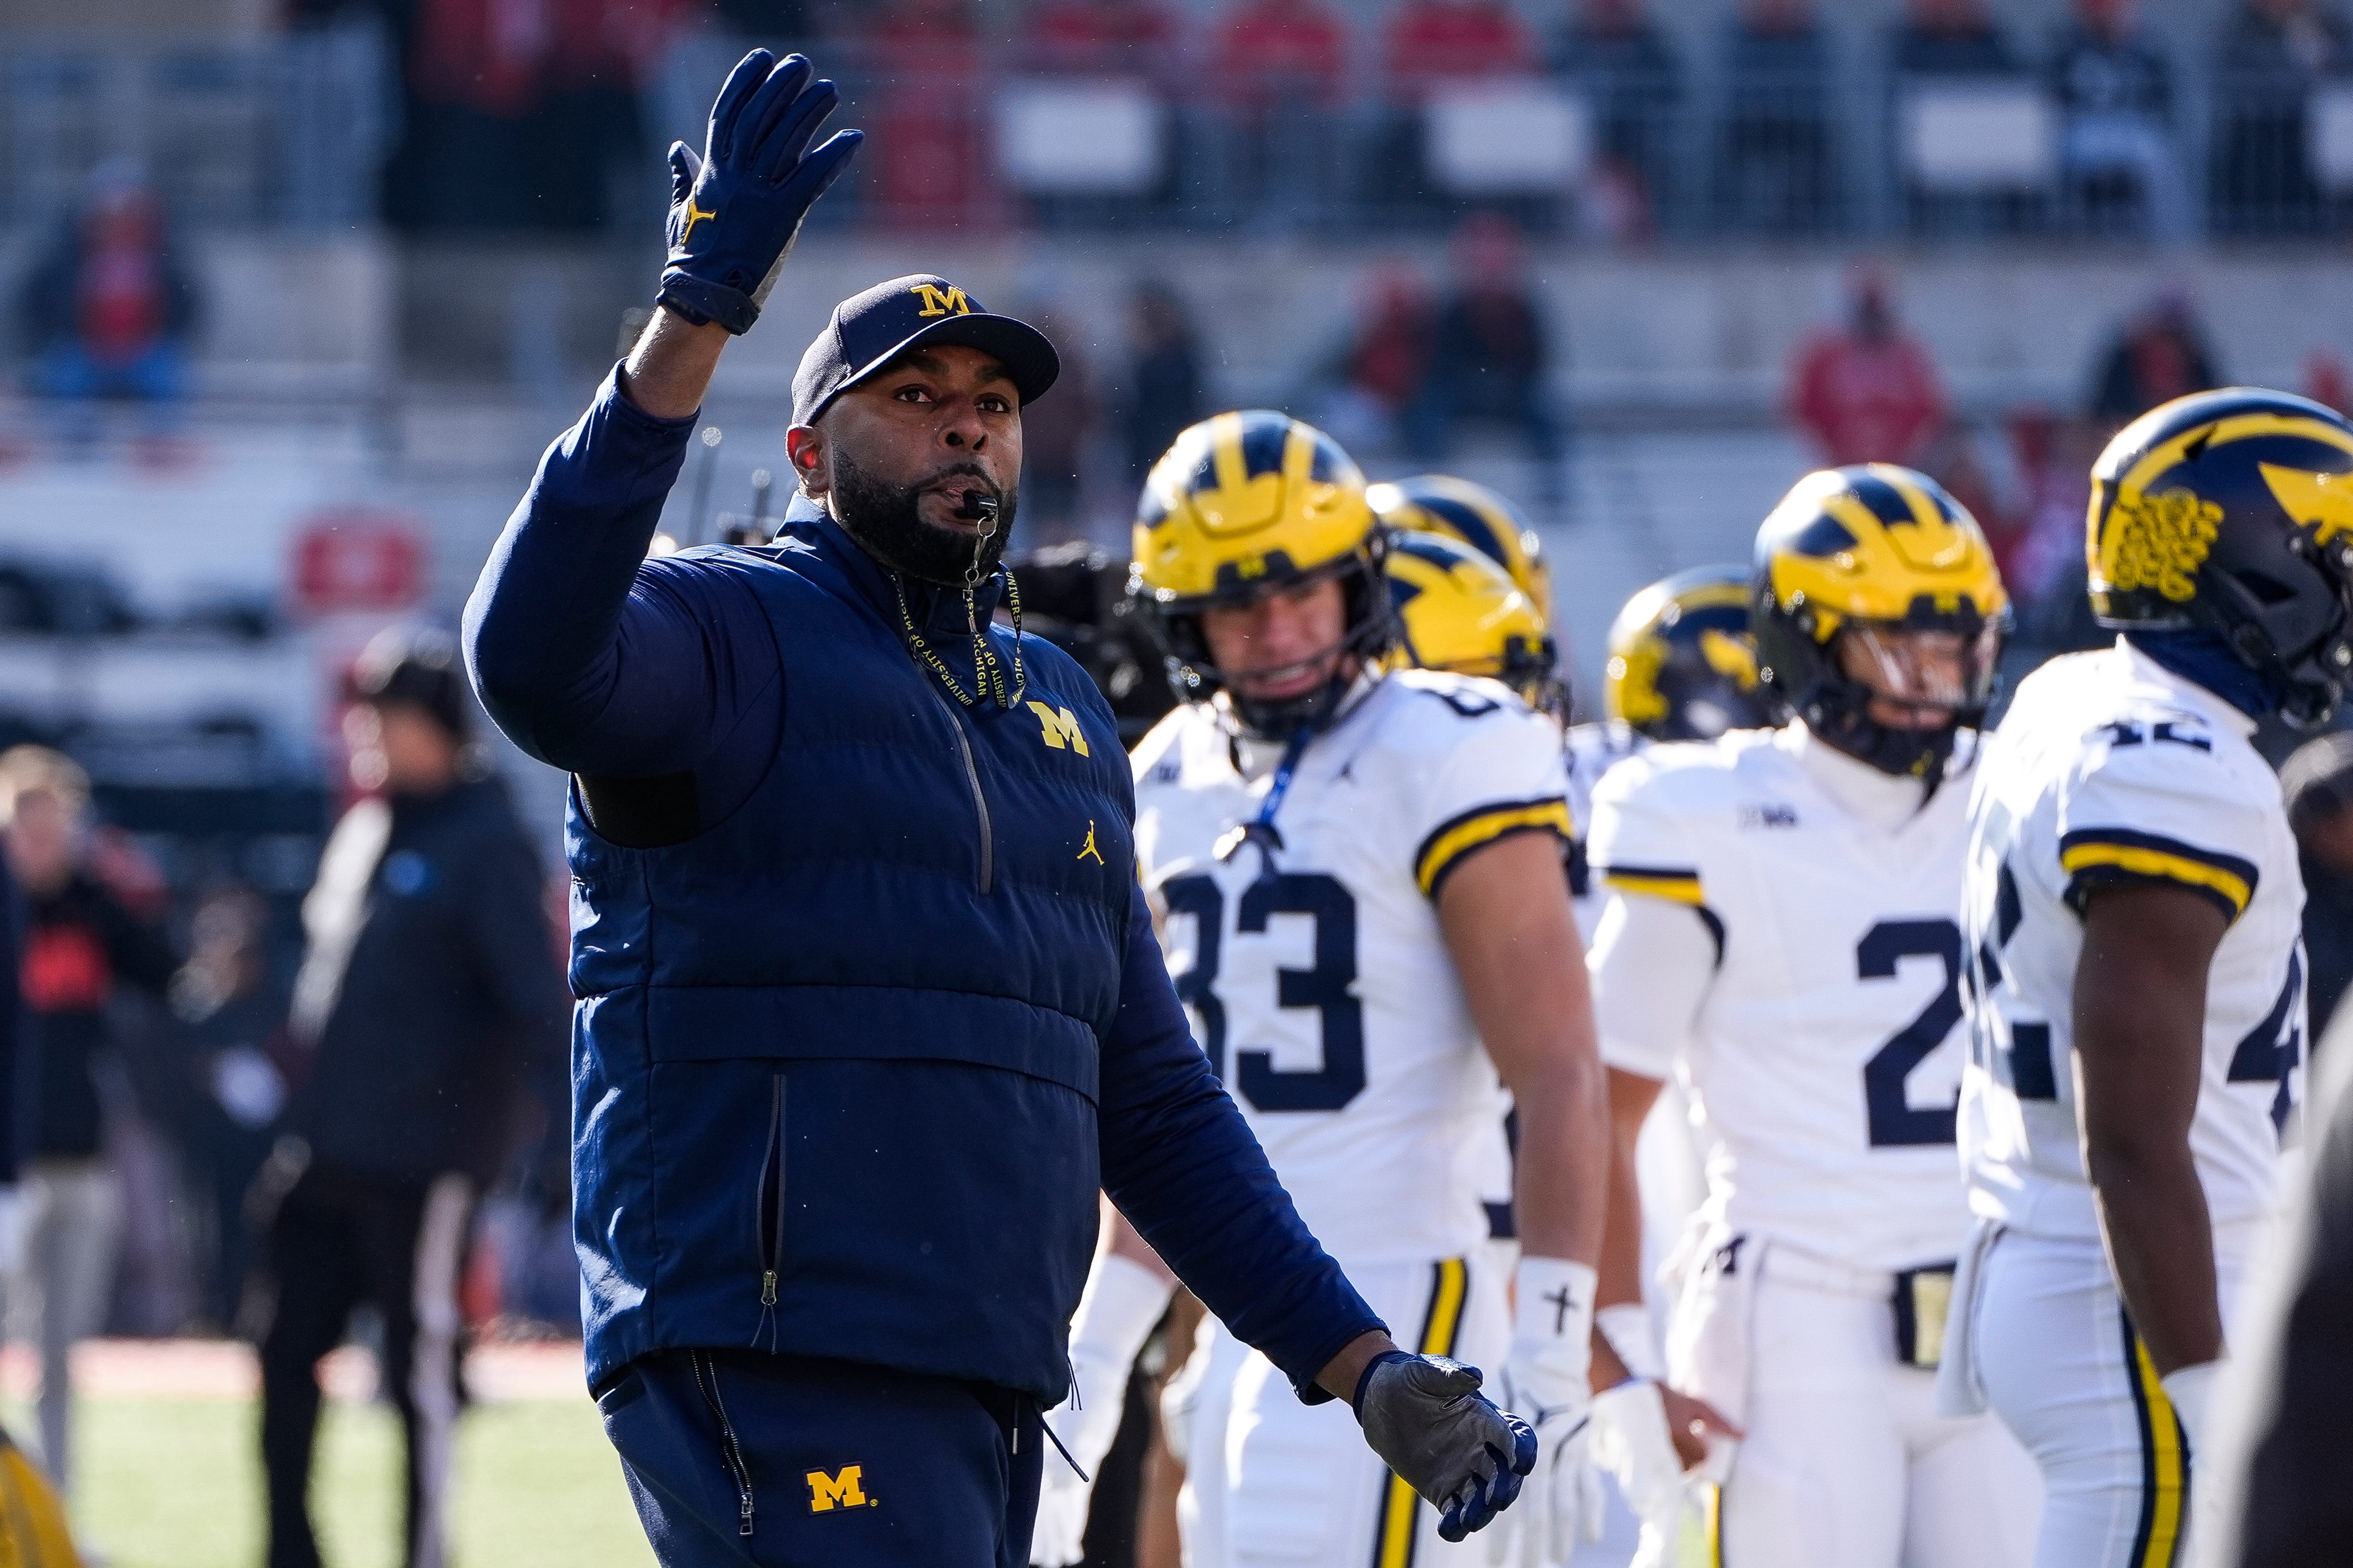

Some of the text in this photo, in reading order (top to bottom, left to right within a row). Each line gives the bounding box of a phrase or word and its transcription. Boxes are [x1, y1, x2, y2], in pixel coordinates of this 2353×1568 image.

[910, 283, 970, 317] M
[1005, 572, 1020, 634] UNIVERSI
[911, 634, 925, 648] OF
[983, 651, 996, 666] OF
[1025, 701, 1089, 758] M
[806, 1465, 867, 1512] M
